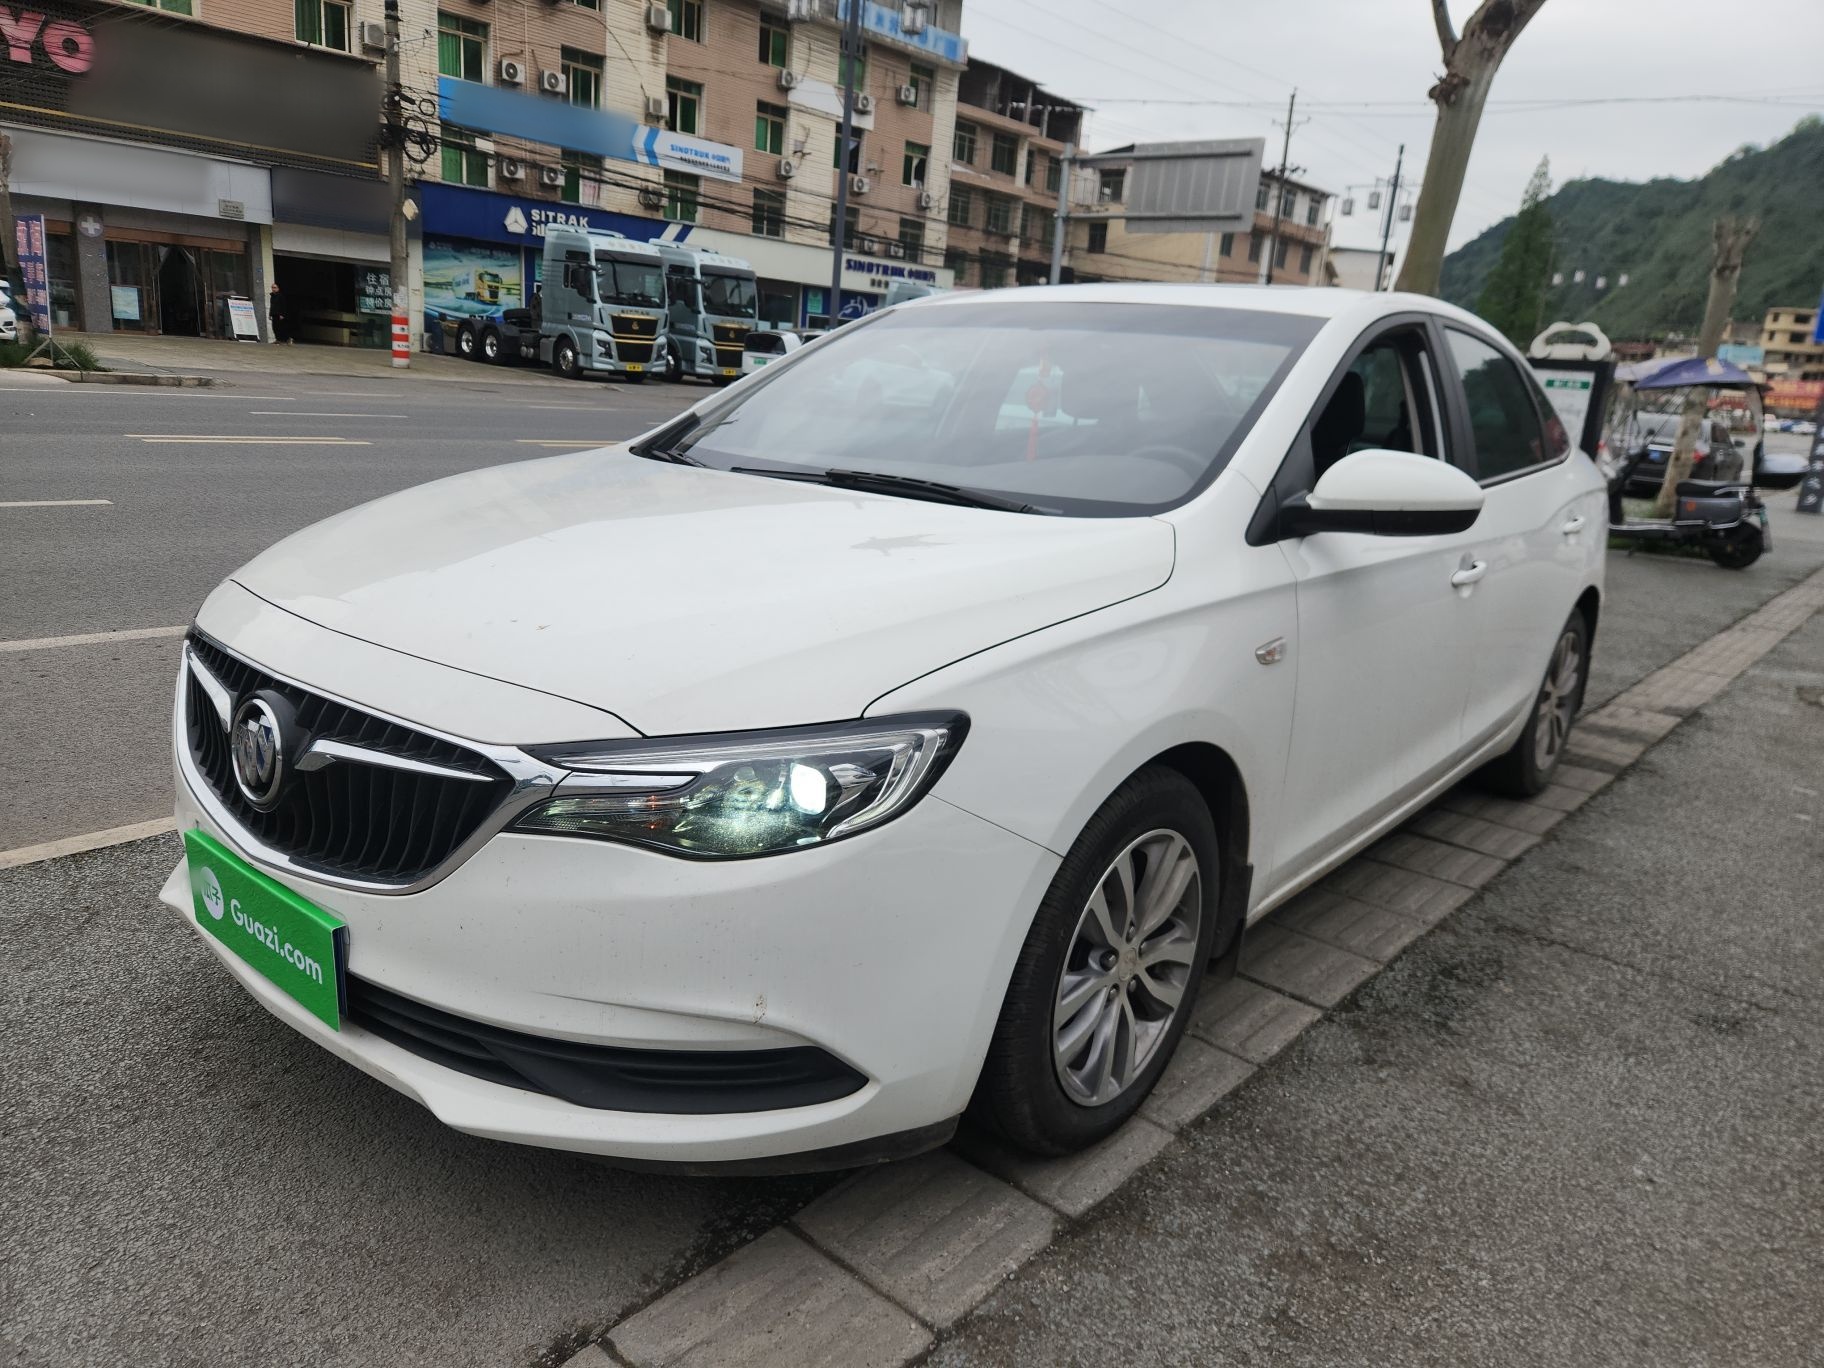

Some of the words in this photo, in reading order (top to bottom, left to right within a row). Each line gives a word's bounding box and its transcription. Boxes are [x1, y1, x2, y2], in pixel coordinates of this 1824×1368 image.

[670, 144, 710, 158] SINOTRUK
[530, 209, 589, 228] SITRAK
[845, 258, 906, 278] SINOTRUK
[366, 272, 390, 286] 住宿
[230, 898, 323, 985] Guazi.com
